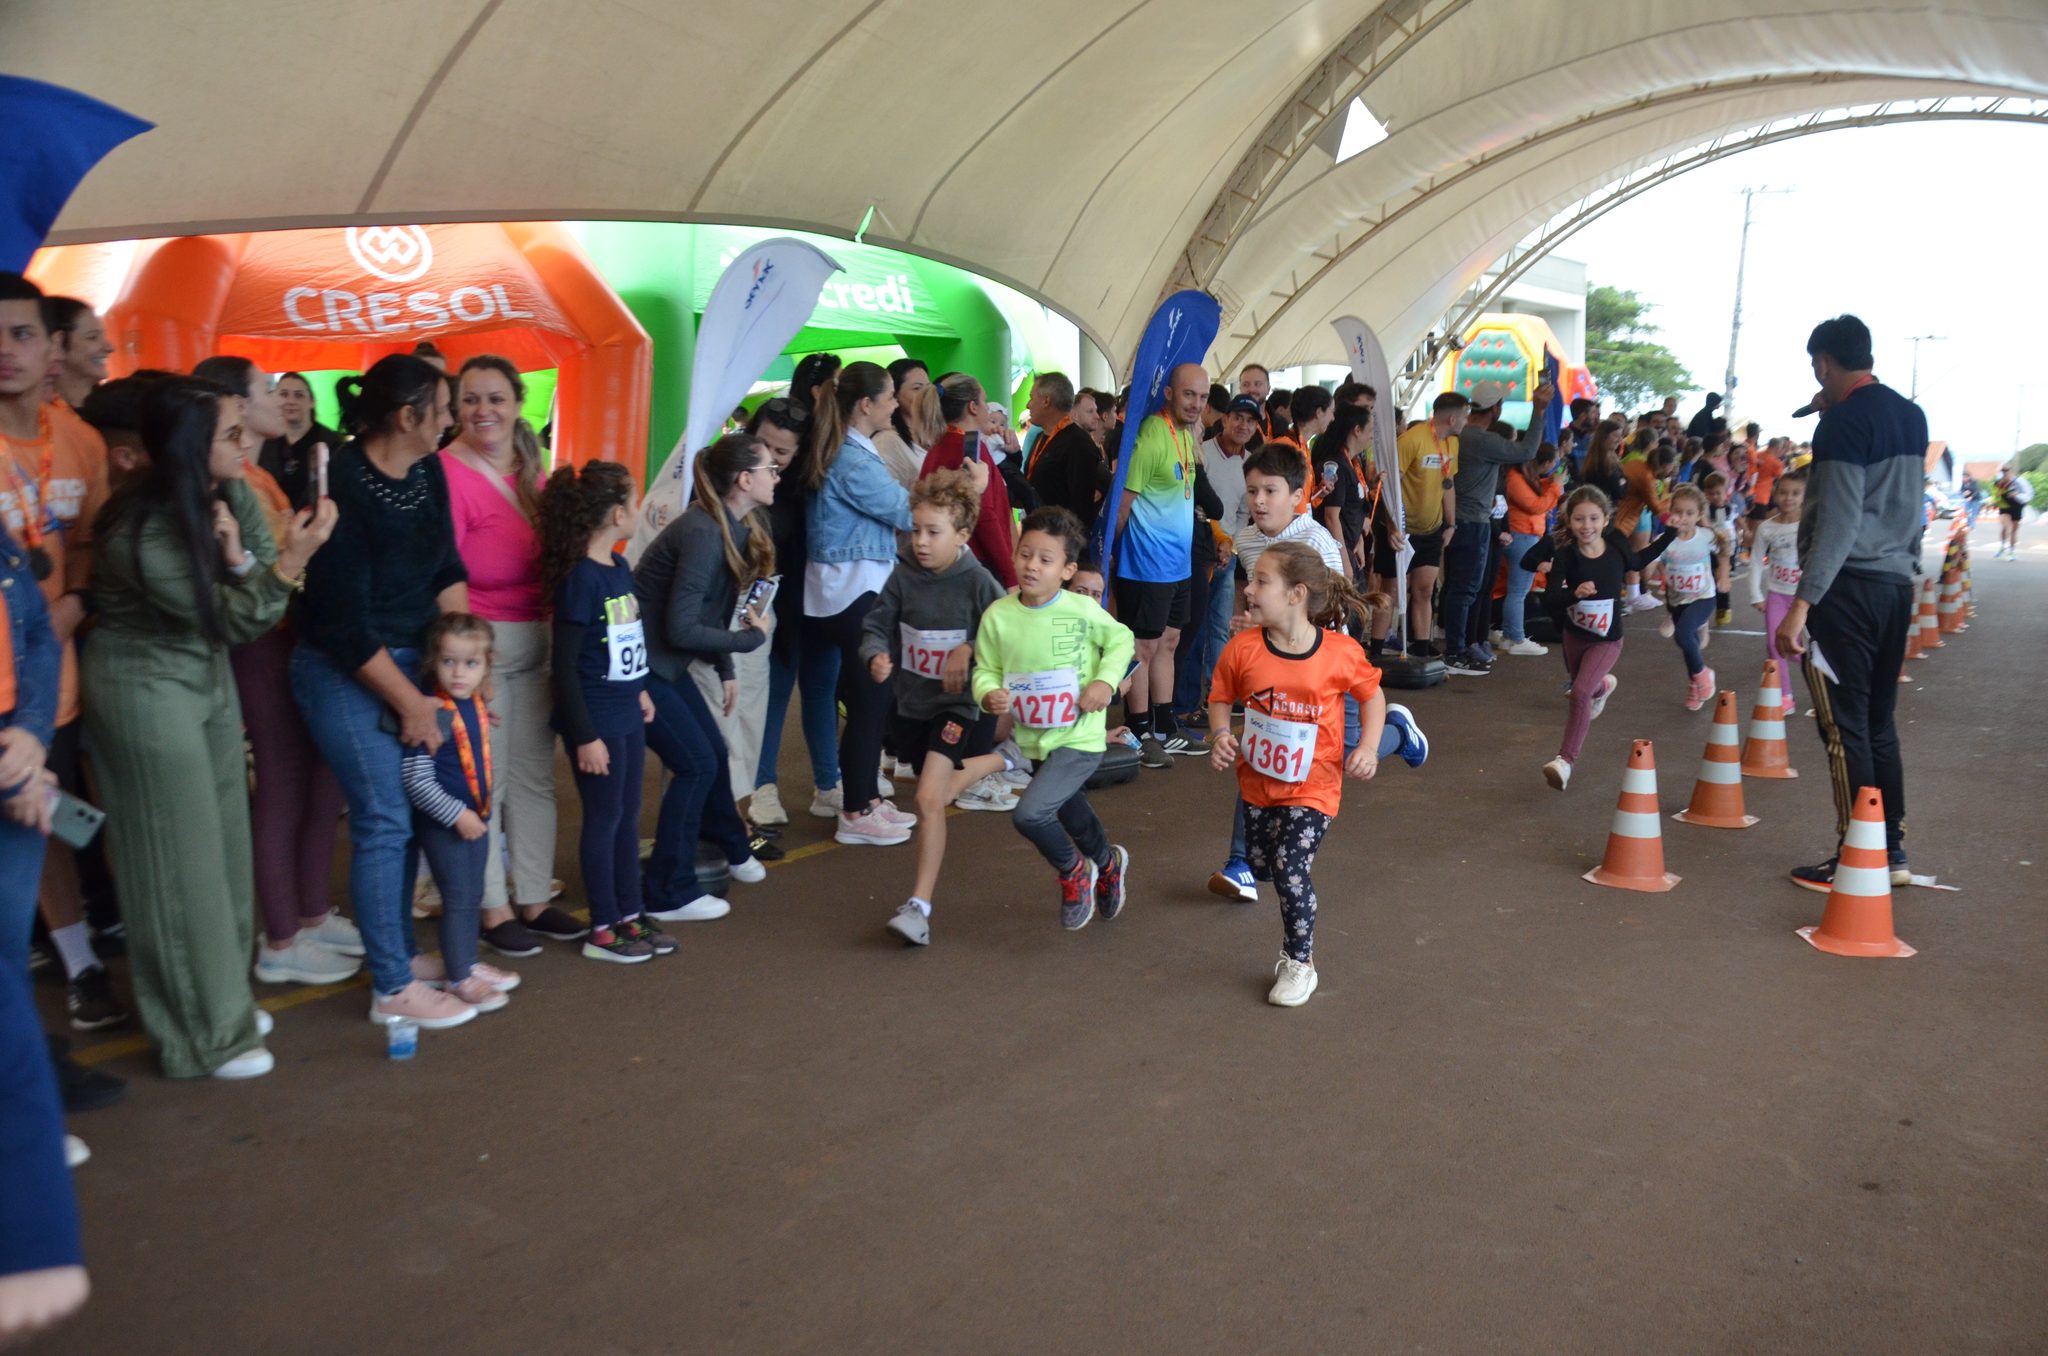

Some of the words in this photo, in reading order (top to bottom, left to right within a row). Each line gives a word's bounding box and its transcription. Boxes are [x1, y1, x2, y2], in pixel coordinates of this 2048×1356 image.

[284, 285, 535, 333] CRESOL
[1670, 574, 1702, 590] 1347
[1570, 607, 1608, 632] 1274
[908, 644, 954, 676] 127
[1012, 691, 1076, 724] 1272
[1247, 733, 1305, 778] 1361
